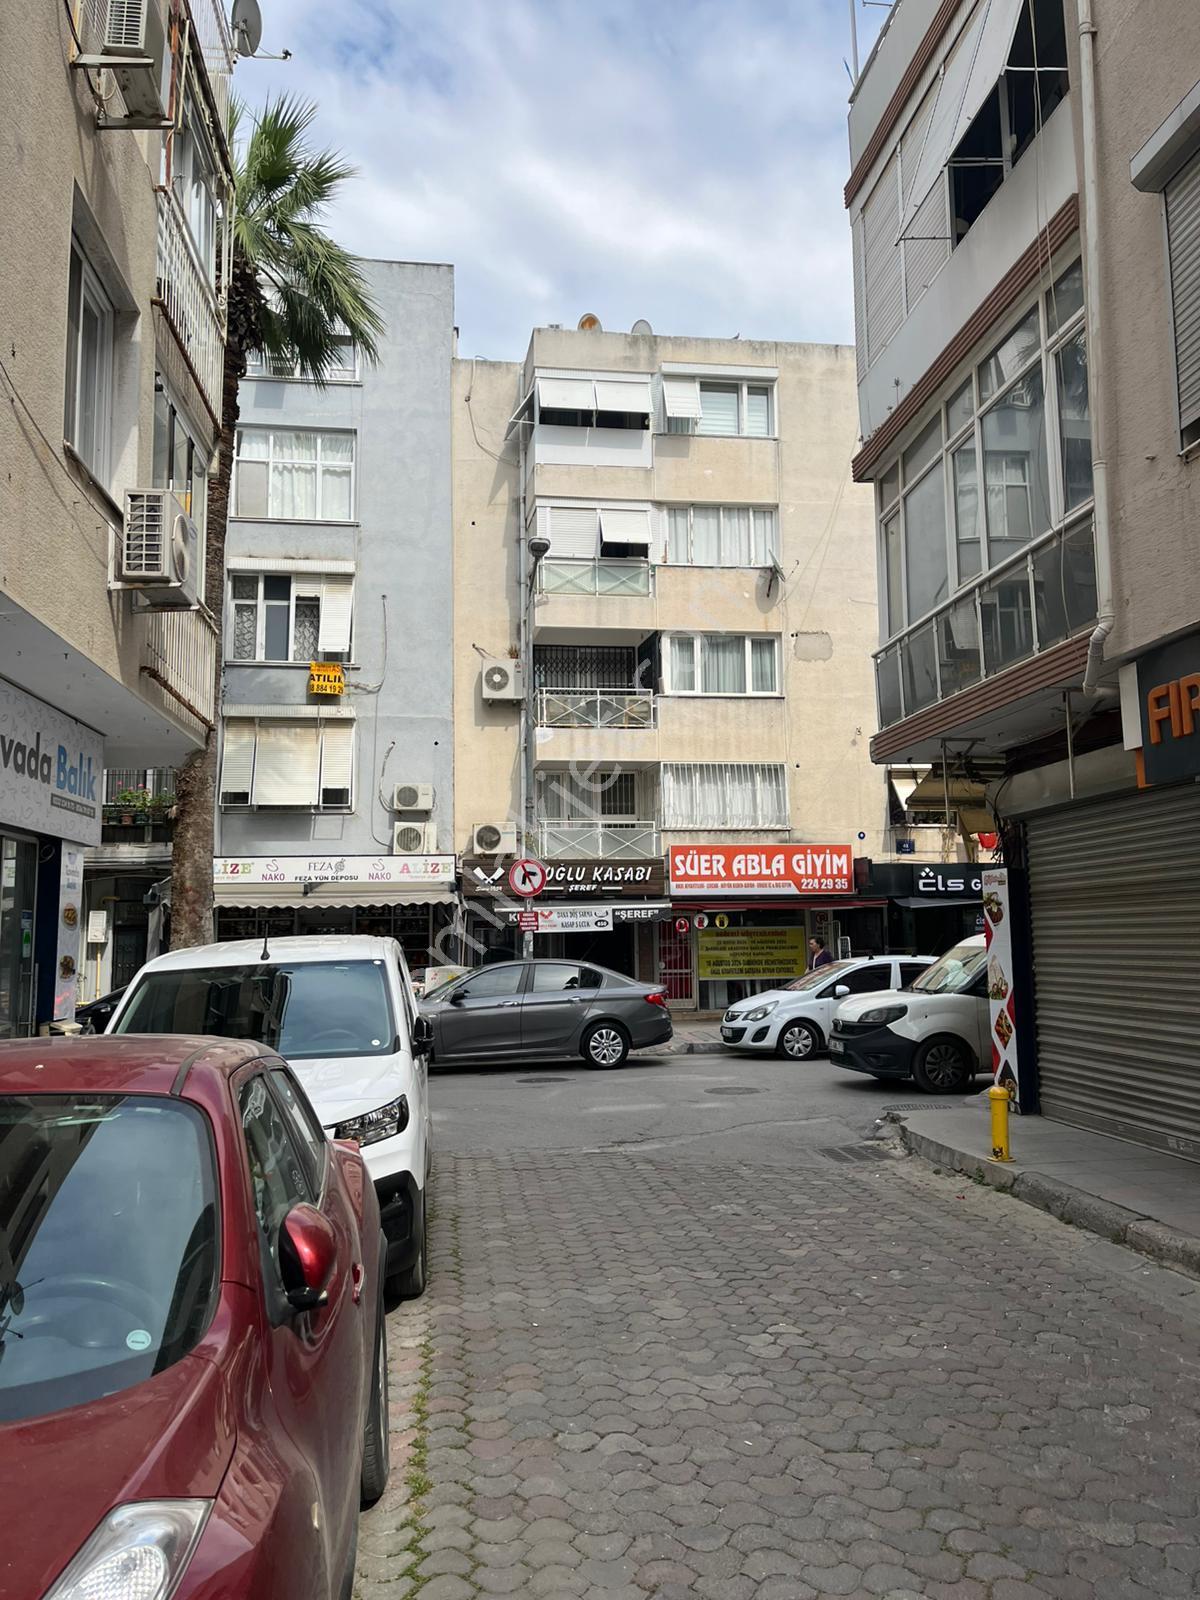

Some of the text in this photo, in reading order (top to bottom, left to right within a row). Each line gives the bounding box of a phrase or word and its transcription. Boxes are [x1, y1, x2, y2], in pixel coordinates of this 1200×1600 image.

[308, 861, 333, 871] FEZA
[399, 859, 451, 874] ALİZE
[675, 849, 848, 877] SÜER ABLA GİYİM
[261, 873, 285, 881] NAKO
[368, 872, 392, 881] NAKO
[592, 866, 651, 882] KASABI
[569, 884, 597, 892] ŞEREF
[801, 879, 819, 890] 224
[821, 879, 833, 890] 29
[835, 879, 848, 889] 35
